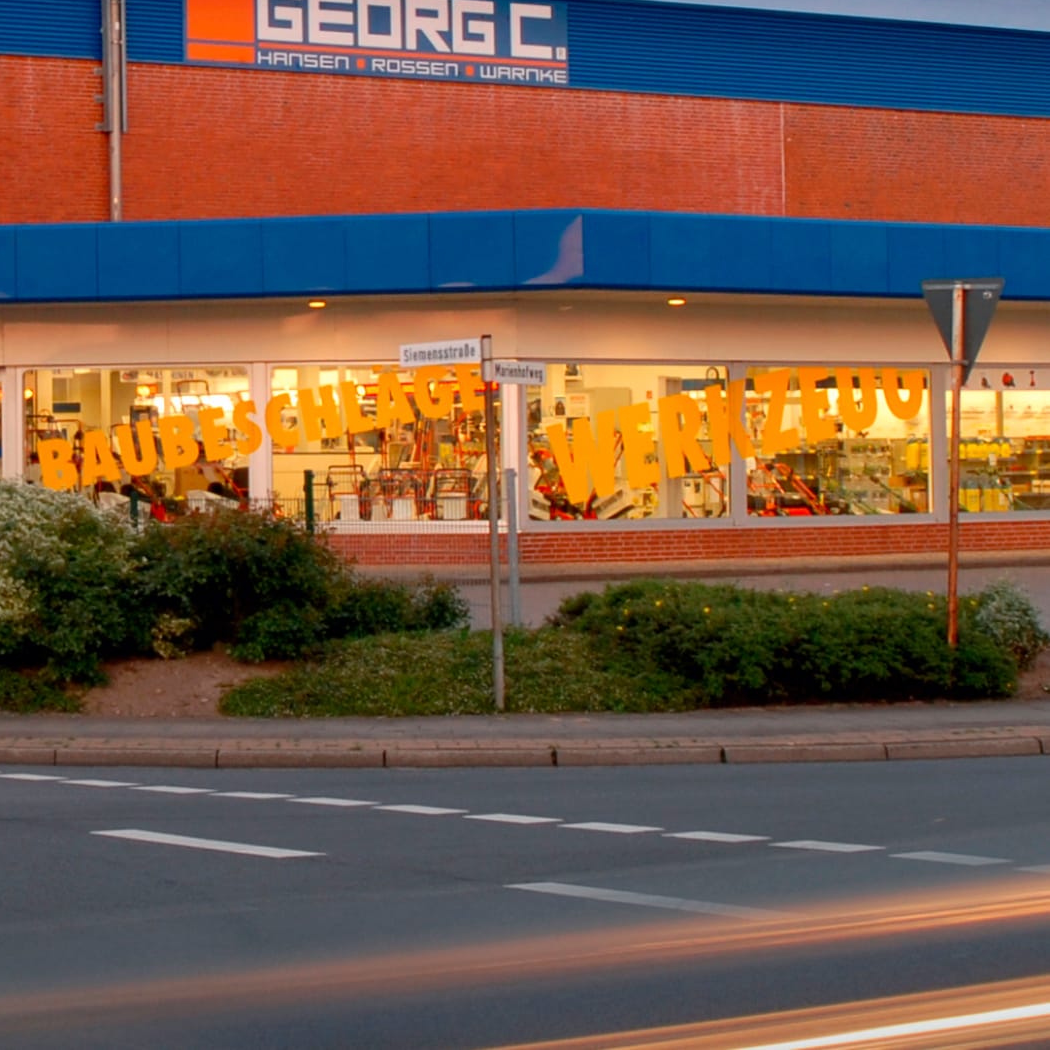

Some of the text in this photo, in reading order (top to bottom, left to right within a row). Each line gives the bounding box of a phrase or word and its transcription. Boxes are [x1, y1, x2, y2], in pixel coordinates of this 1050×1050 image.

[257, 51, 567, 84] HANSEN ROSSEN WARNKE
[403, 343, 477, 363] Siemensstraße
